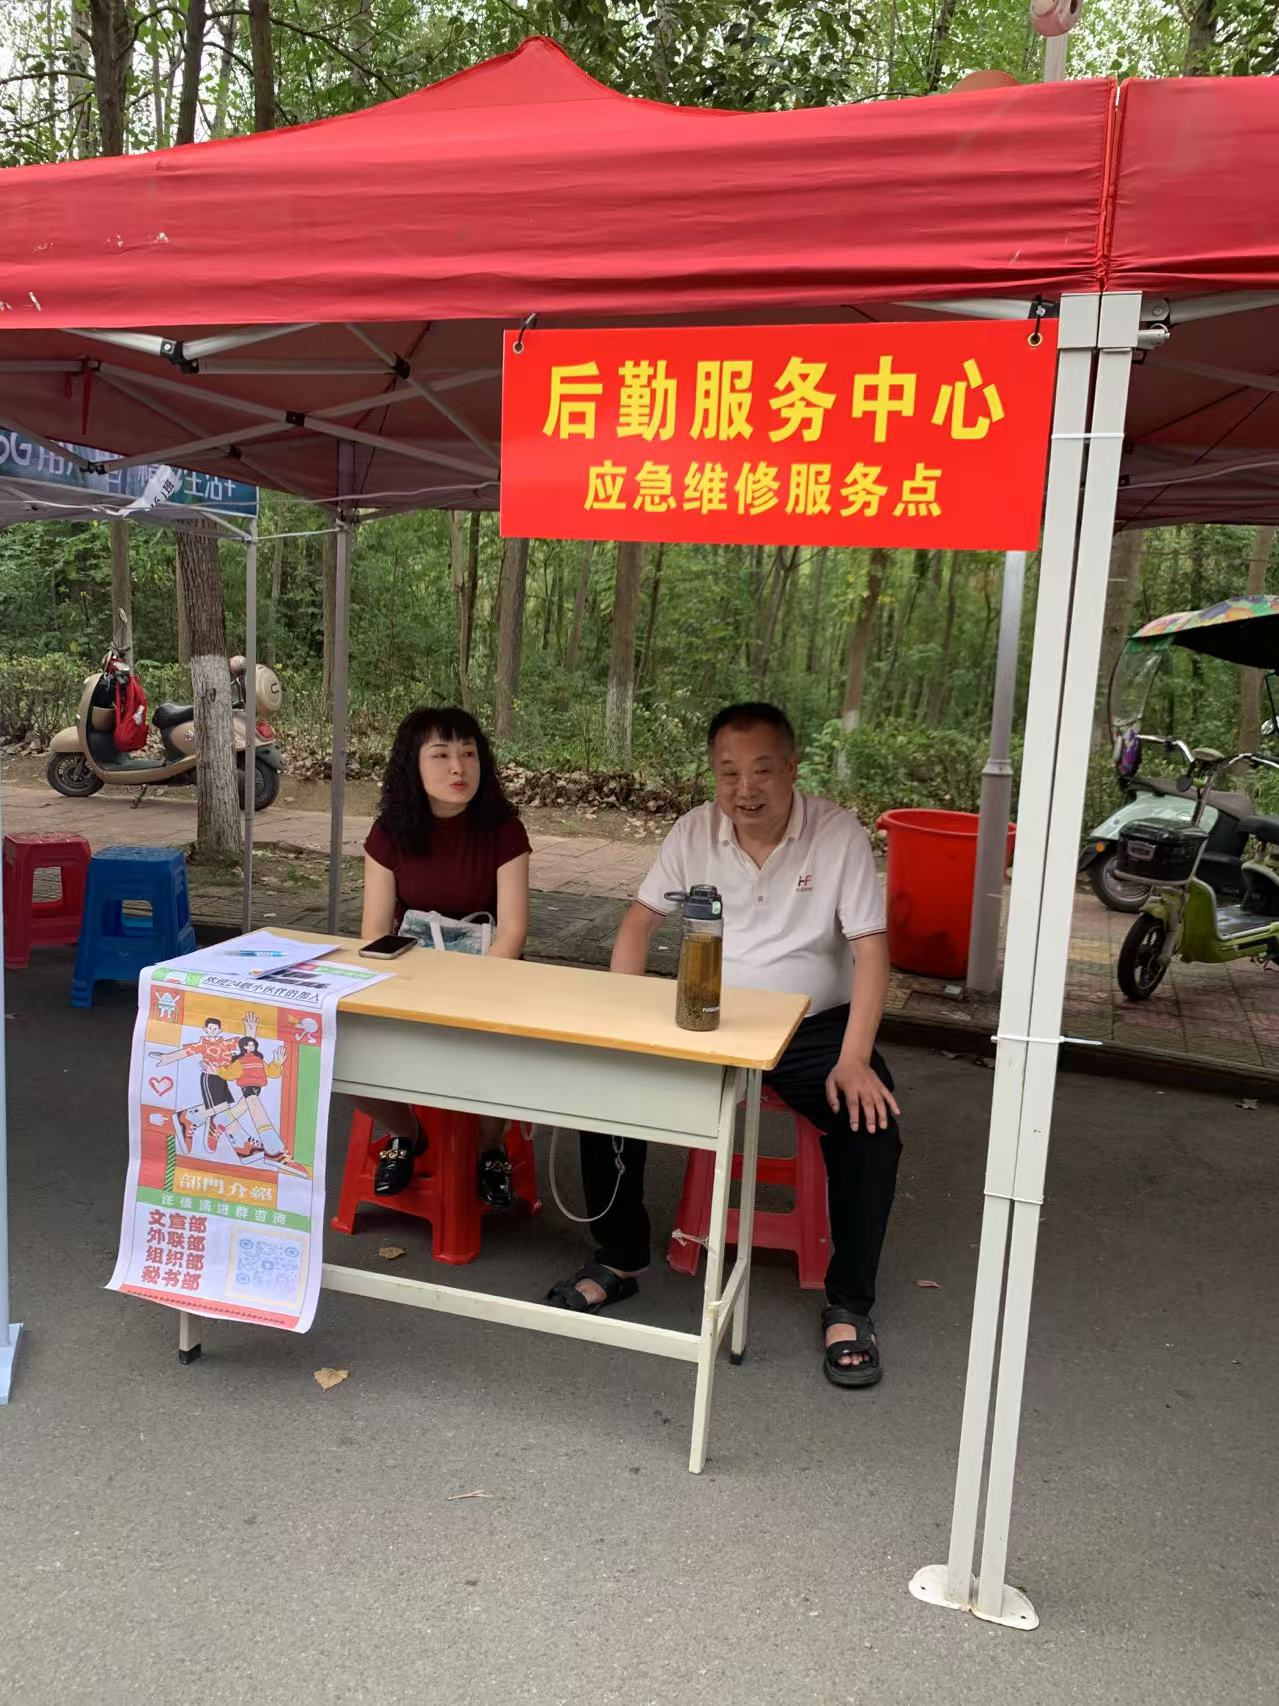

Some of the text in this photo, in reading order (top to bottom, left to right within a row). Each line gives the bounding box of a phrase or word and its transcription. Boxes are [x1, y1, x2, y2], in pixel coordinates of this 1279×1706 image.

[542, 355, 1005, 443] 后勤服务中心
[584, 460, 943, 518] 应急维修服务点
[148, 1208, 208, 1234] 文宣部
[146, 1226, 206, 1253] 外联部
[145, 1245, 205, 1271] 组织部
[141, 1265, 202, 1291] 秘书部
